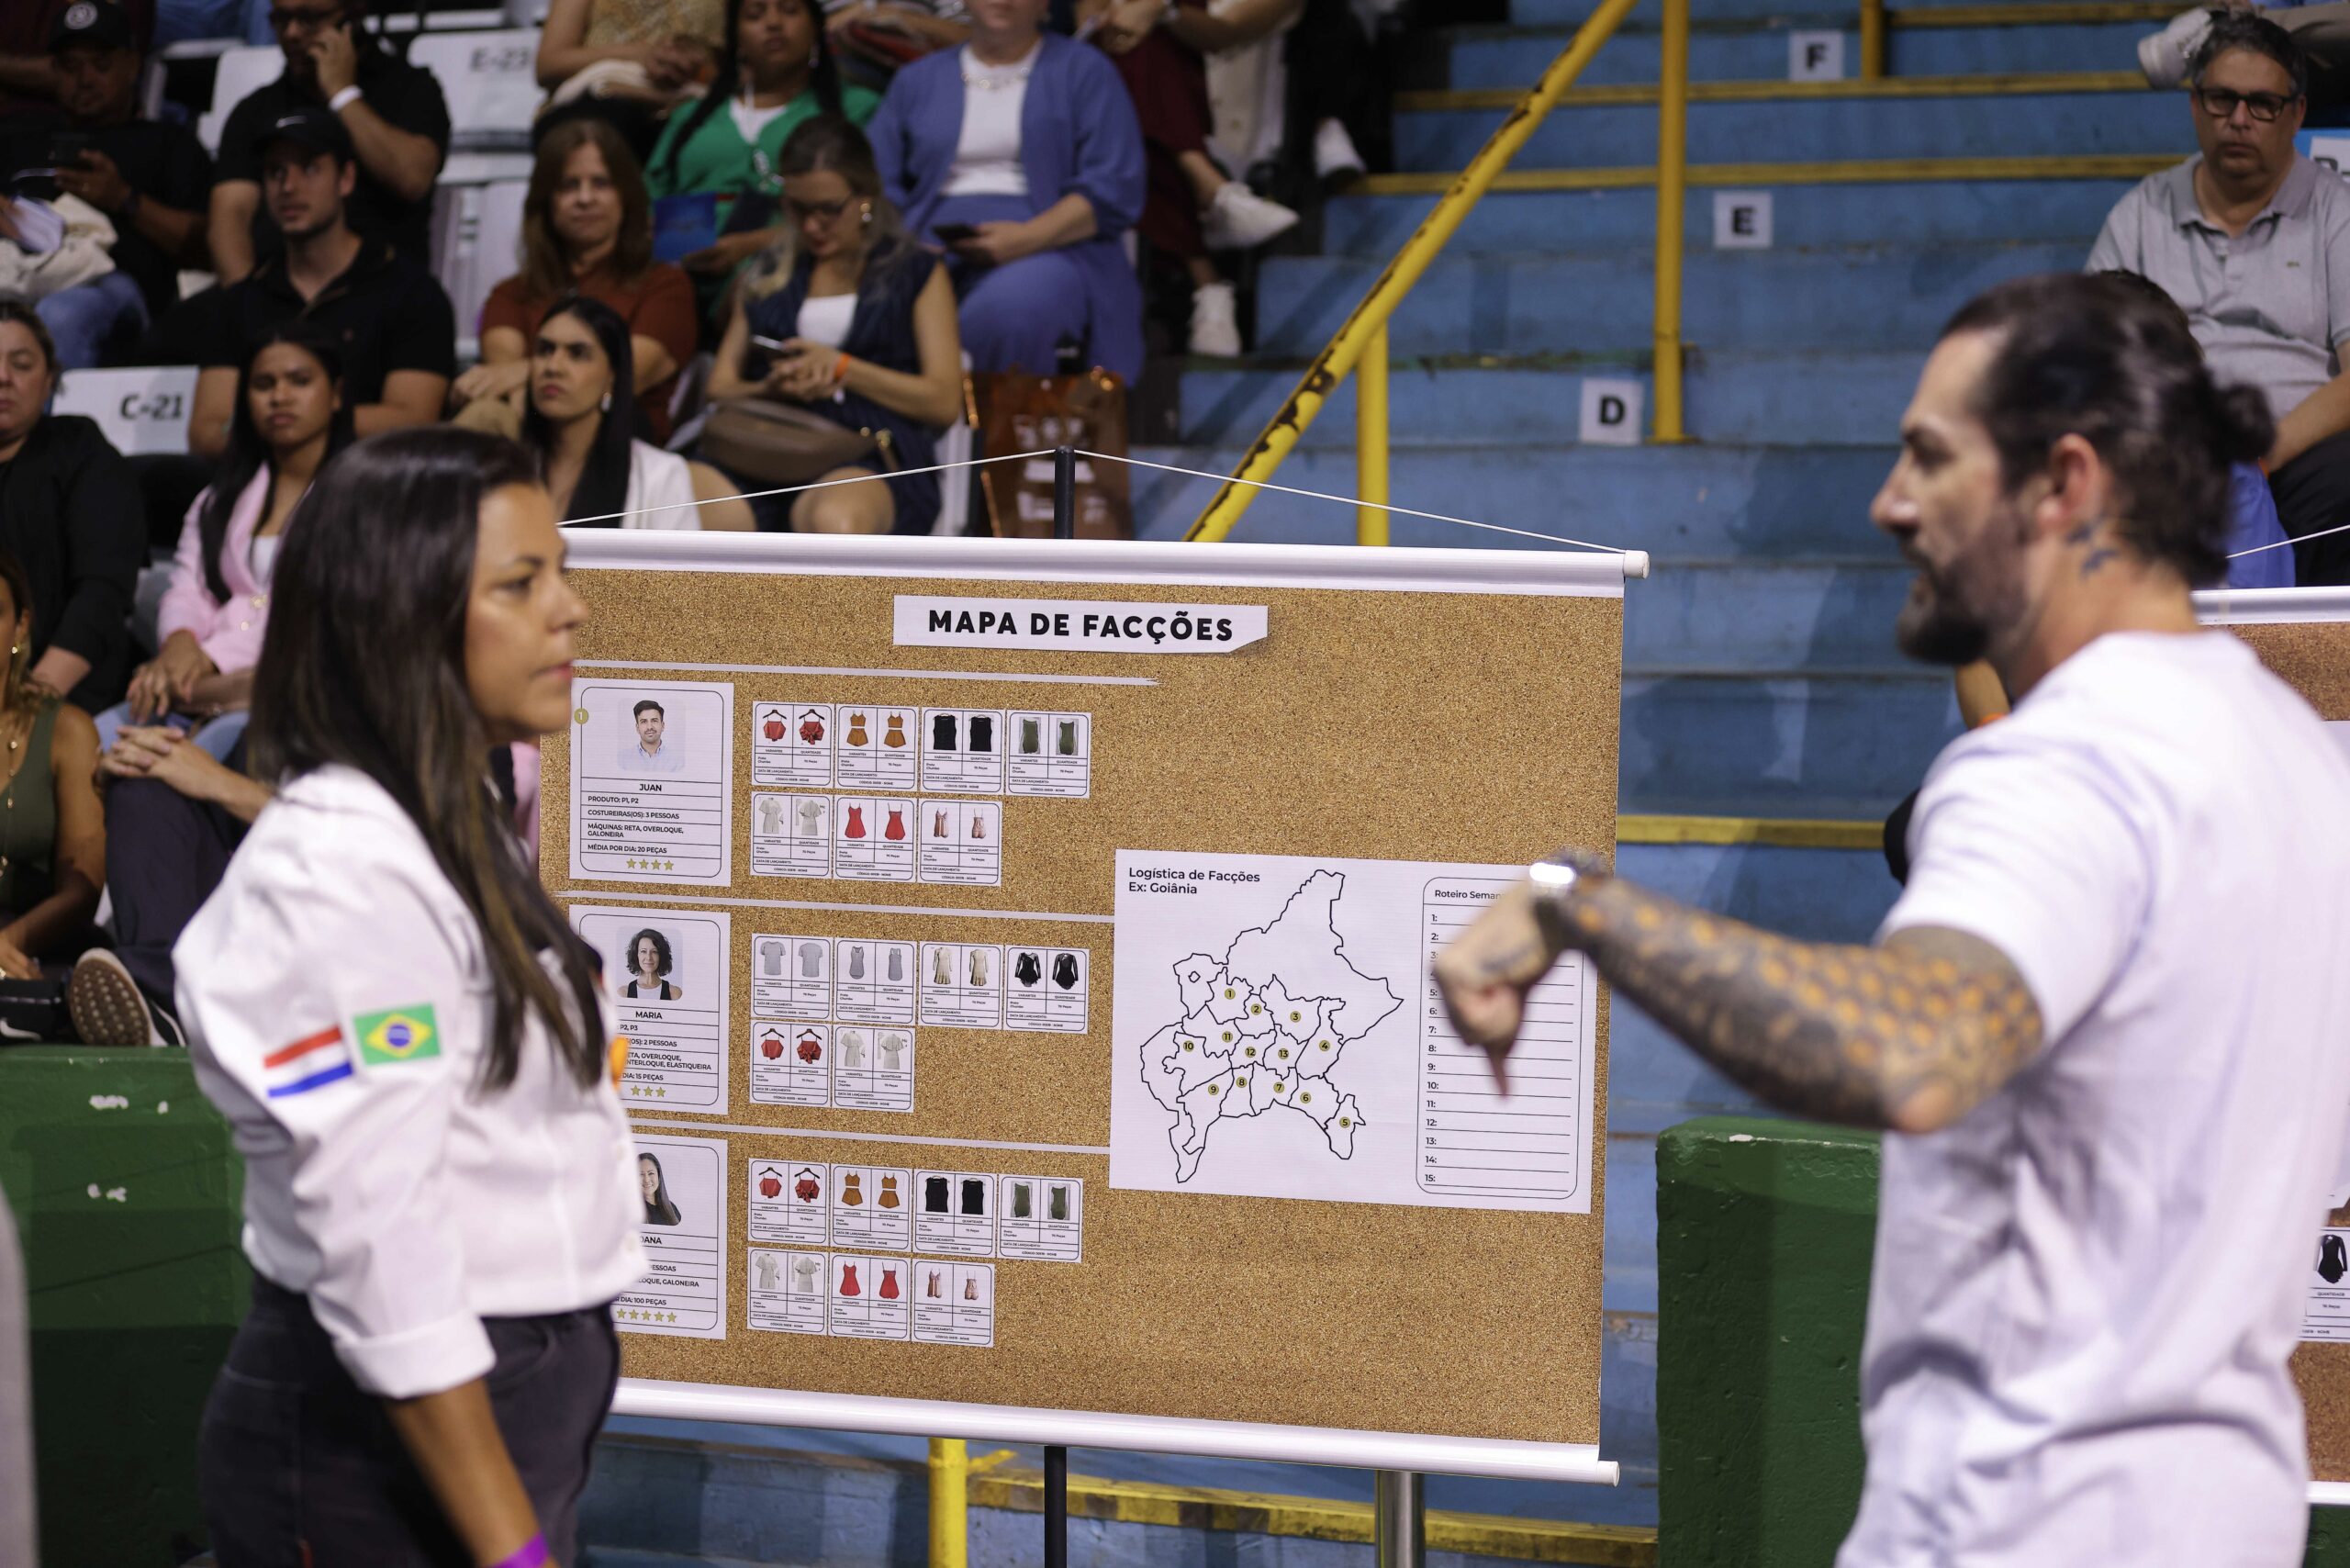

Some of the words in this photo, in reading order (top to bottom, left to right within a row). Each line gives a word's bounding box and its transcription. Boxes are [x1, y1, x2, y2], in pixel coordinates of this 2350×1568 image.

[1805, 44, 1828, 71] F
[1731, 207, 1756, 236] E
[120, 394, 183, 420] C-21
[1598, 396, 1626, 426] D
[929, 610, 1018, 635] MAPA
[1030, 612, 1069, 636] DE
[1082, 610, 1233, 644] FACÇÕES
[639, 783, 662, 791] JUAN
[588, 810, 644, 819] COSTUREIRAS(OS):
[588, 823, 623, 831] MÁQUINAS:
[643, 825, 684, 834] OVERLOQUE,
[1129, 868, 1185, 880] Logística
[1188, 869, 1205, 880] de
[1208, 870, 1260, 884] Facções
[1129, 882, 1147, 892] Ex:
[1149, 882, 1198, 894] Goiânia
[1435, 890, 1468, 899] Roteiro
[1470, 890, 1502, 900] Seman
[1430, 933, 1438, 941] 2:
[1430, 951, 1438, 959] 3:
[635, 1011, 663, 1019] MARIA
[1429, 1007, 1438, 1015] 6:
[1428, 1025, 1437, 1034] 7:
[1427, 1081, 1439, 1090] 10:
[1427, 1100, 1436, 1108] 11:
[1426, 1118, 1438, 1126] 12:
[1425, 1155, 1438, 1164] 14:
[662, 1279, 699, 1287] GALONEIRA
